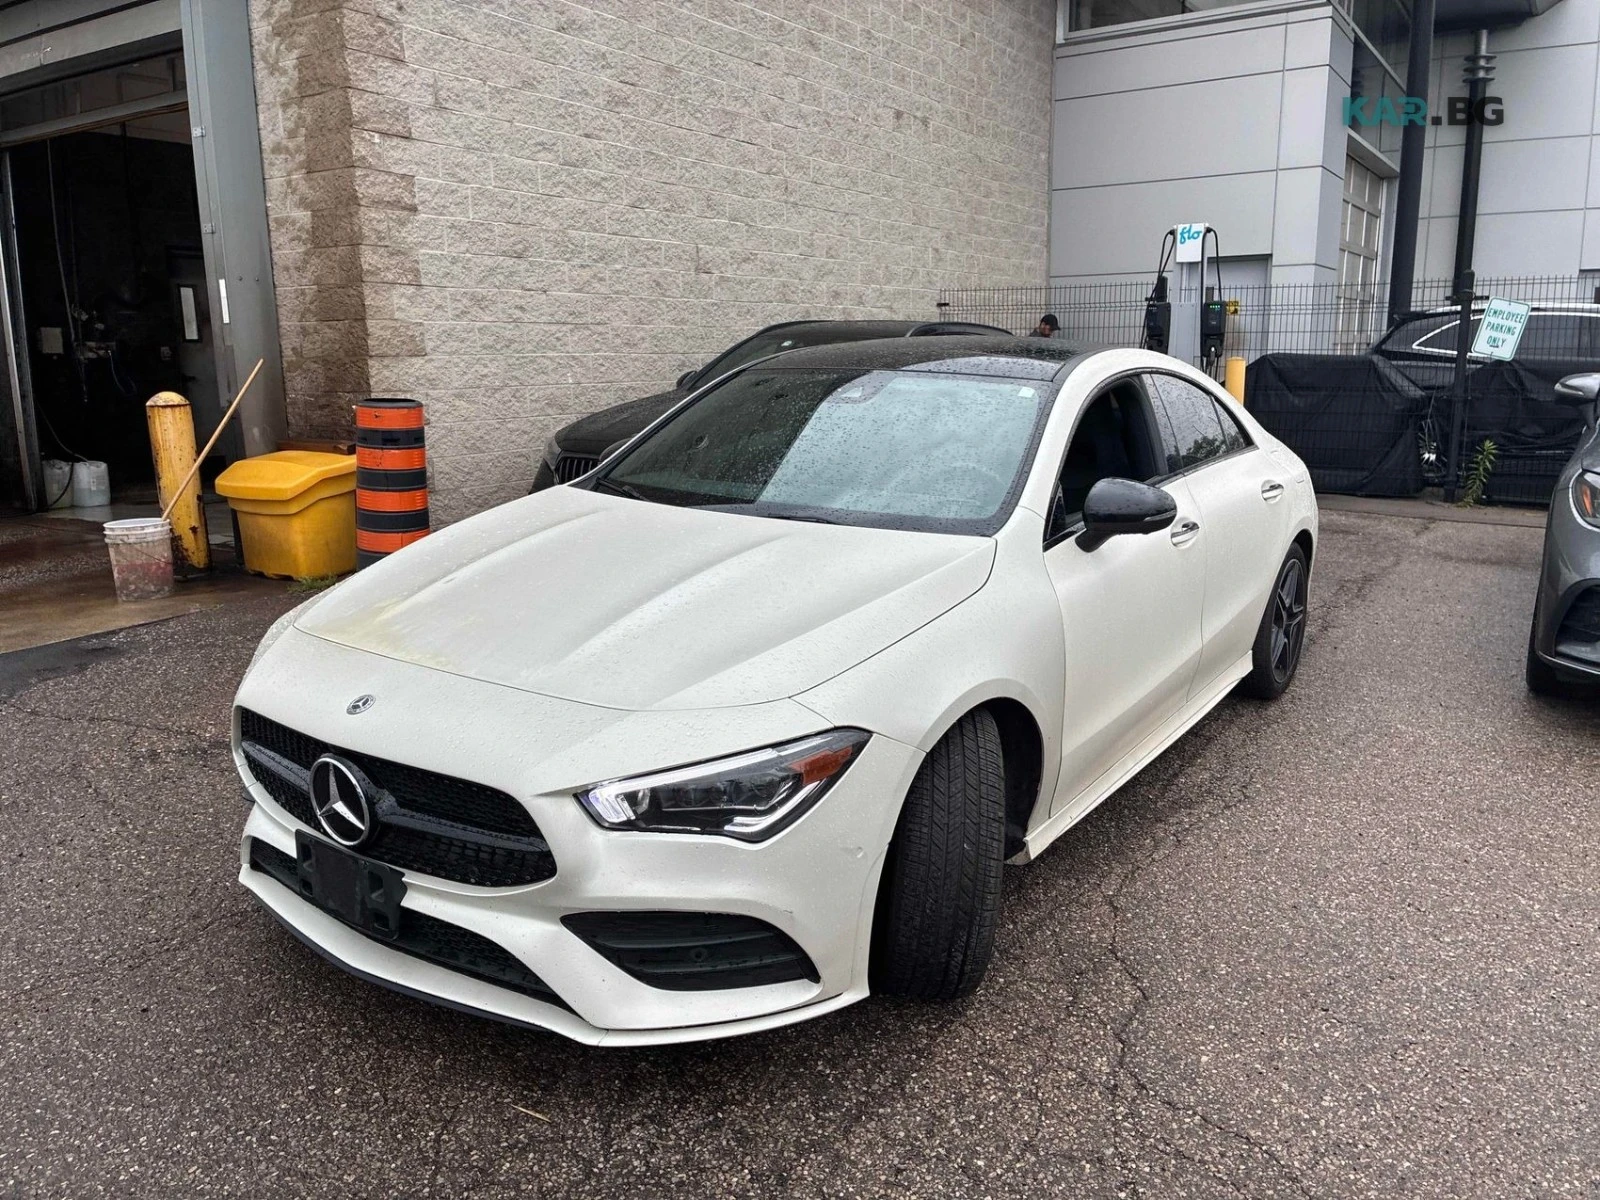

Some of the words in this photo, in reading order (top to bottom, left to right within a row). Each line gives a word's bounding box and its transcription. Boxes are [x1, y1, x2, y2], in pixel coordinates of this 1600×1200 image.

[1179, 224, 1202, 244] flo
[1487, 308, 1524, 323] EMPLOYEE
[1485, 321, 1516, 336] PARKING
[1486, 335, 1507, 348] ONLY
